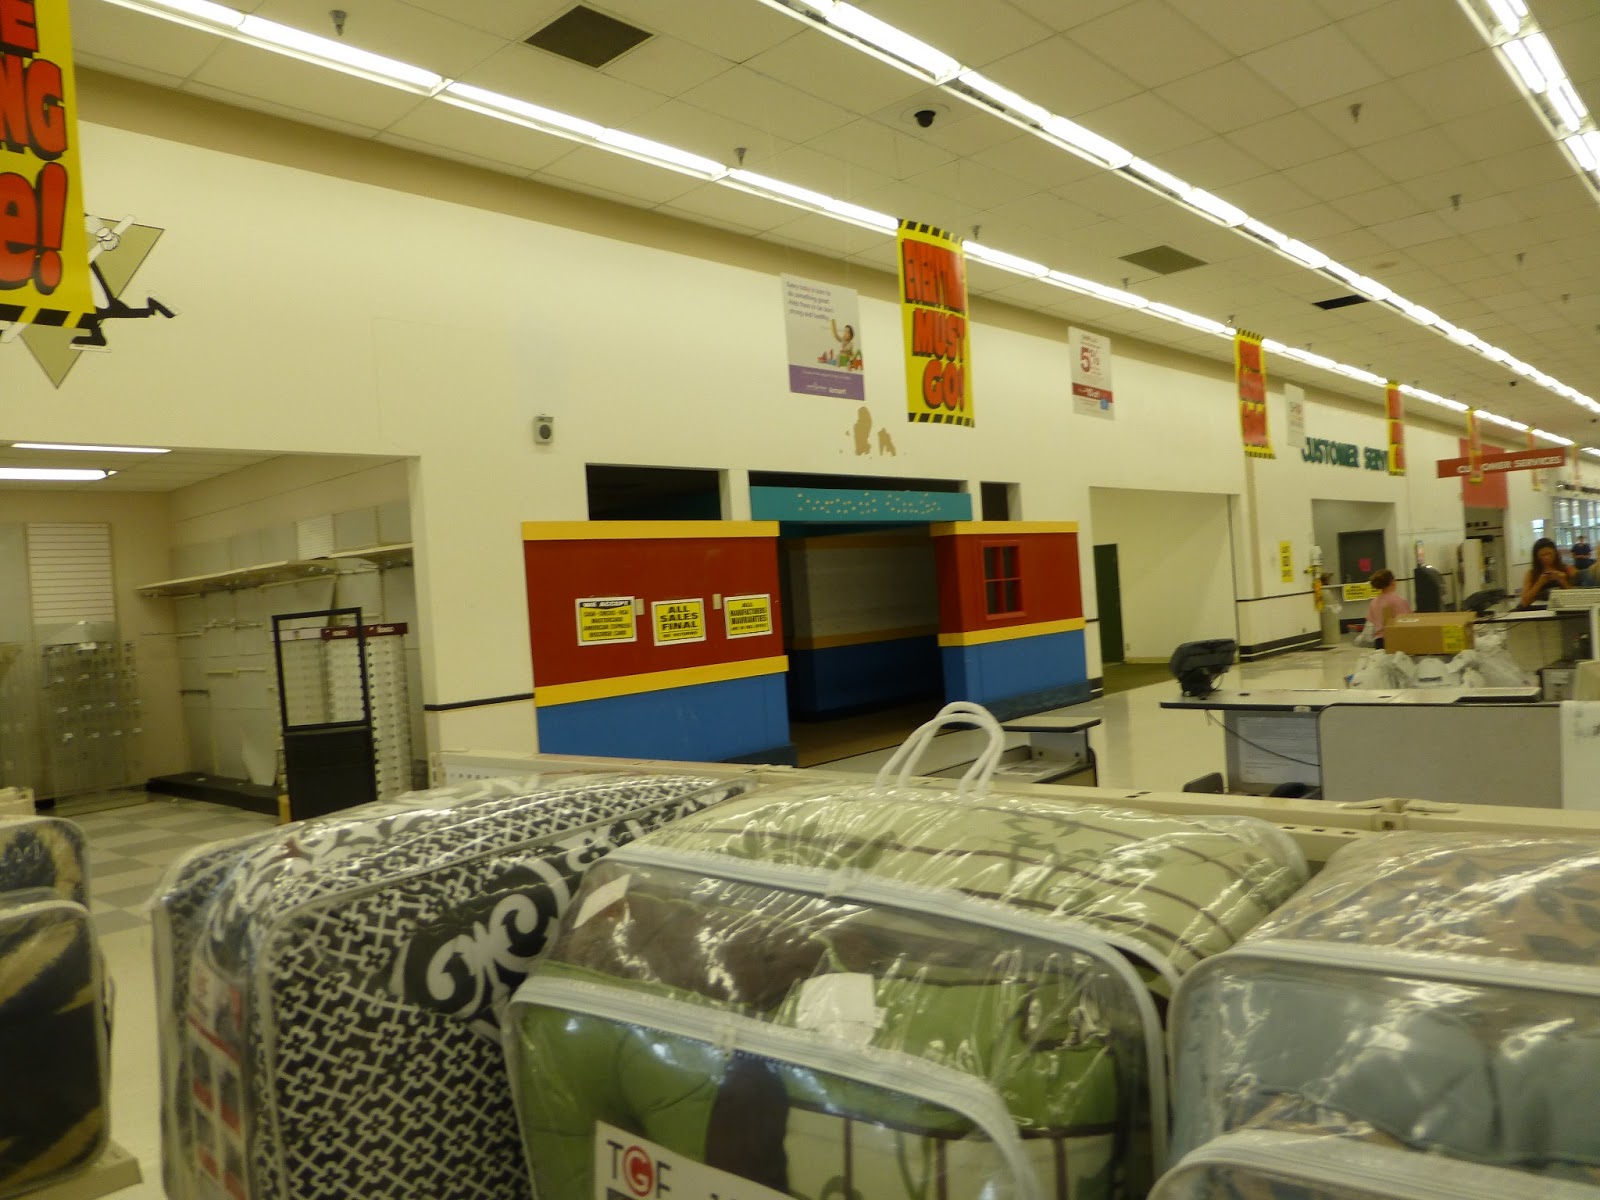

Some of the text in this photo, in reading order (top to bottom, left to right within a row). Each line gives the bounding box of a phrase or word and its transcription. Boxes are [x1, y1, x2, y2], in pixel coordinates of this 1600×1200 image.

[912, 307, 966, 362] MUST
[922, 359, 966, 412] GO!
[1457, 461, 1512, 473] CUOMER
[668, 605, 690, 614] ALL
[660, 612, 699, 623] SALES
[662, 621, 698, 631] FINAL
